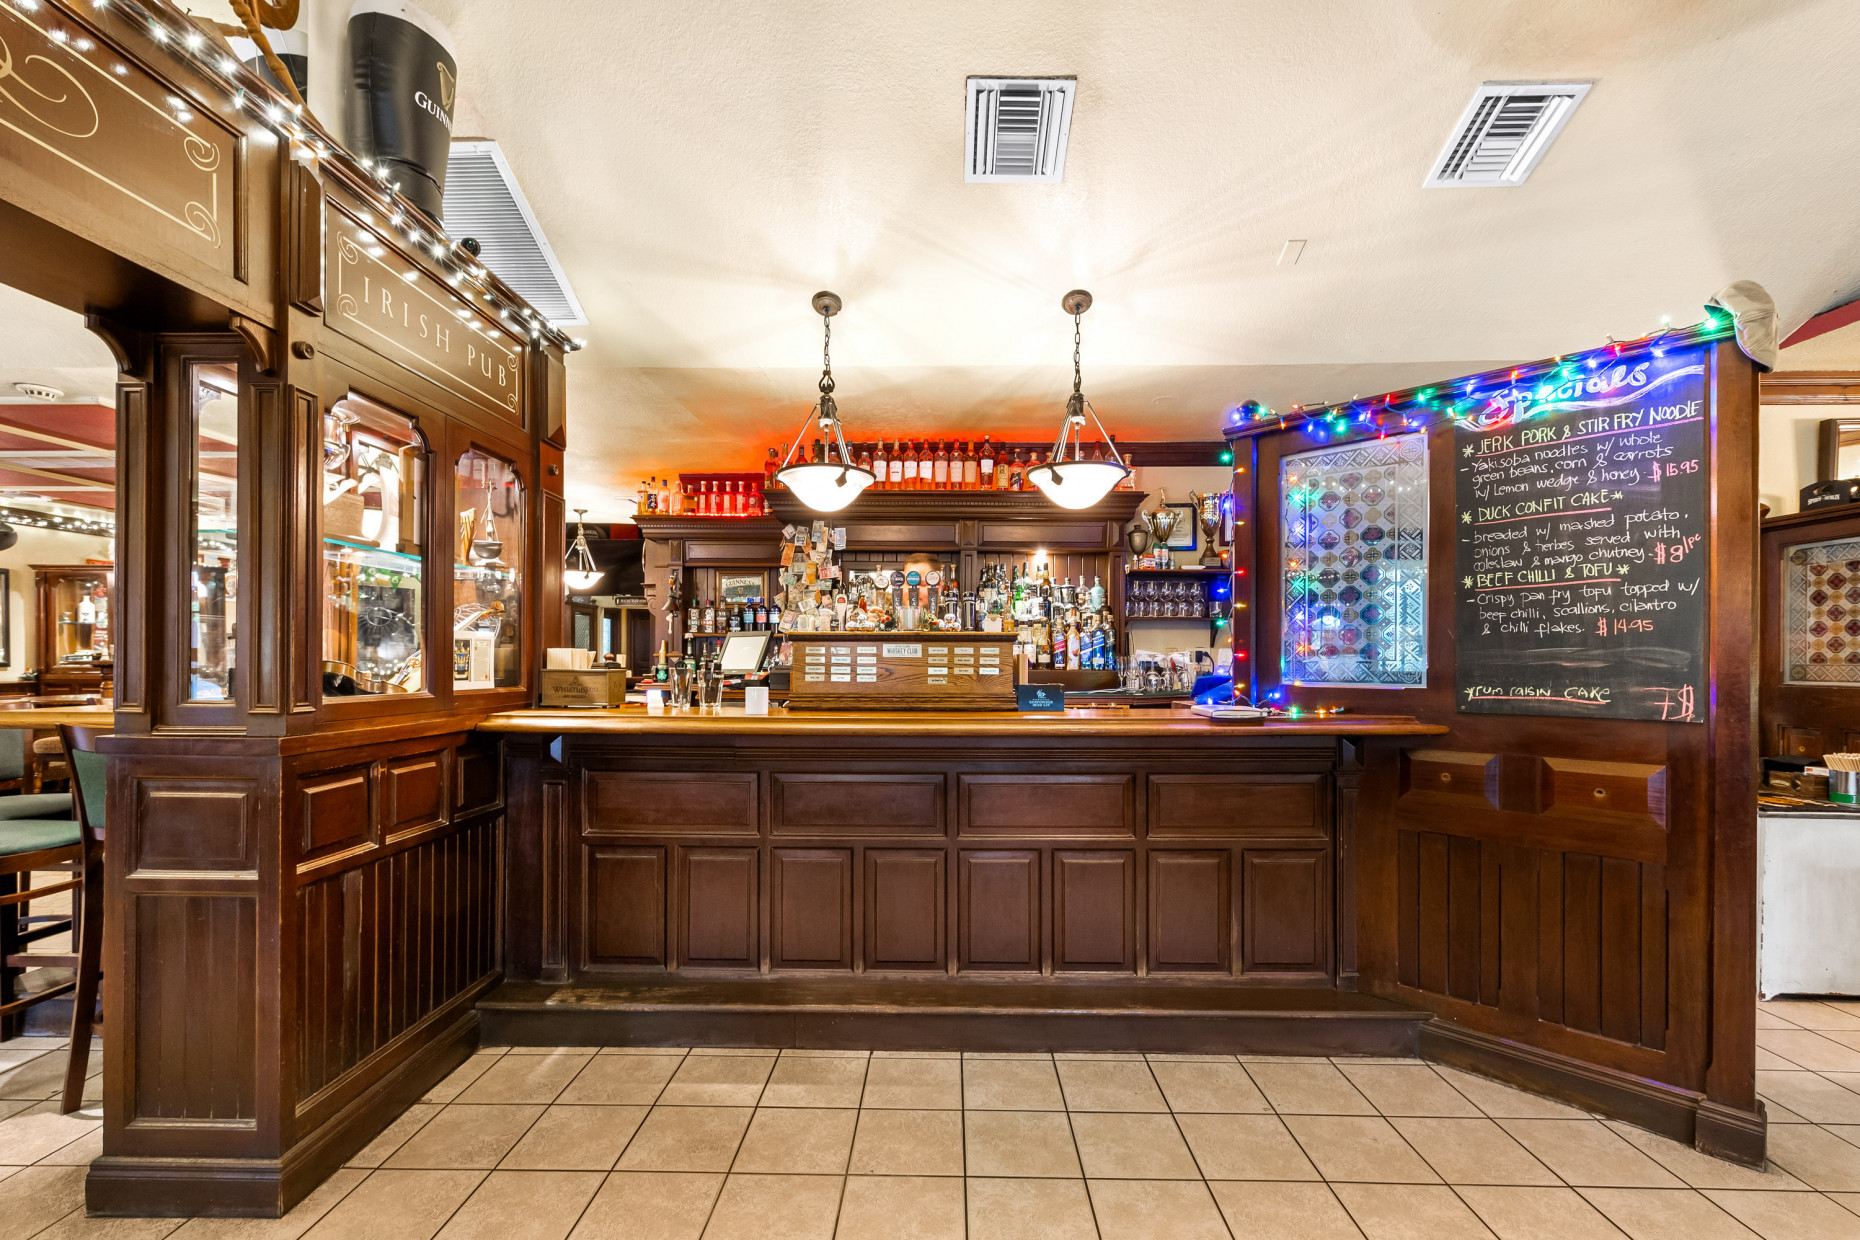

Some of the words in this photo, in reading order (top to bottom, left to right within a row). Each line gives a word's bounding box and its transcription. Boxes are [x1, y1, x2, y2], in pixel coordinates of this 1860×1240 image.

[364, 276, 450, 353] IRISH
[467, 344, 507, 387] PUB
[1477, 362, 1650, 426] Specials
[1477, 435, 1514, 454] JERK
[1521, 426, 1557, 446] PORK
[1561, 424, 1571, 441] &
[1577, 417, 1610, 435] STIR
[1613, 408, 1645, 431] FRY
[1649, 400, 1703, 426] NOODLE
[1534, 444, 1589, 461] noodles
[1596, 437, 1615, 457] w/
[1619, 430, 1664, 447] whole
[1472, 471, 1505, 490] green
[1554, 458, 1588, 470] corn
[1593, 453, 1608, 470] &
[1613, 444, 1675, 461] carrots
[1475, 484, 1490, 502] w/
[1536, 473, 1580, 492] wedge
[1586, 469, 1598, 486] &
[1601, 467, 1641, 486] honey
[1478, 503, 1512, 522] DUCK
[1515, 496, 1567, 516] CONFIT
[1570, 489, 1610, 507] CAKE
[1473, 525, 1528, 544] breaded
[1535, 522, 1551, 540] w/
[1559, 513, 1615, 533] mashed
[1474, 544, 1511, 559] onions
[1522, 540, 1532, 556] &
[1584, 530, 1631, 546] served
[1644, 523, 1681, 539] with
[1473, 556, 1523, 572] coleslaw
[1530, 555, 1541, 569] &
[1544, 553, 1584, 568] mango
[1588, 546, 1645, 563] chutney
[1477, 571, 1514, 588] BEEF
[1517, 568, 1556, 583] CHILLI
[1564, 566, 1575, 579] &
[1577, 561, 1613, 578] TOFU
[1519, 591, 1545, 608] pan
[1548, 588, 1571, 606] fry
[1578, 585, 1612, 602] tofu
[1620, 579, 1670, 599] topped
[1677, 577, 1701, 596] w/
[1480, 606, 1507, 624] beef
[1619, 598, 1677, 613] cilantro
[1481, 622, 1491, 636] &
[1500, 620, 1530, 634] chilli
[907, 647, 919, 655] CLUB
